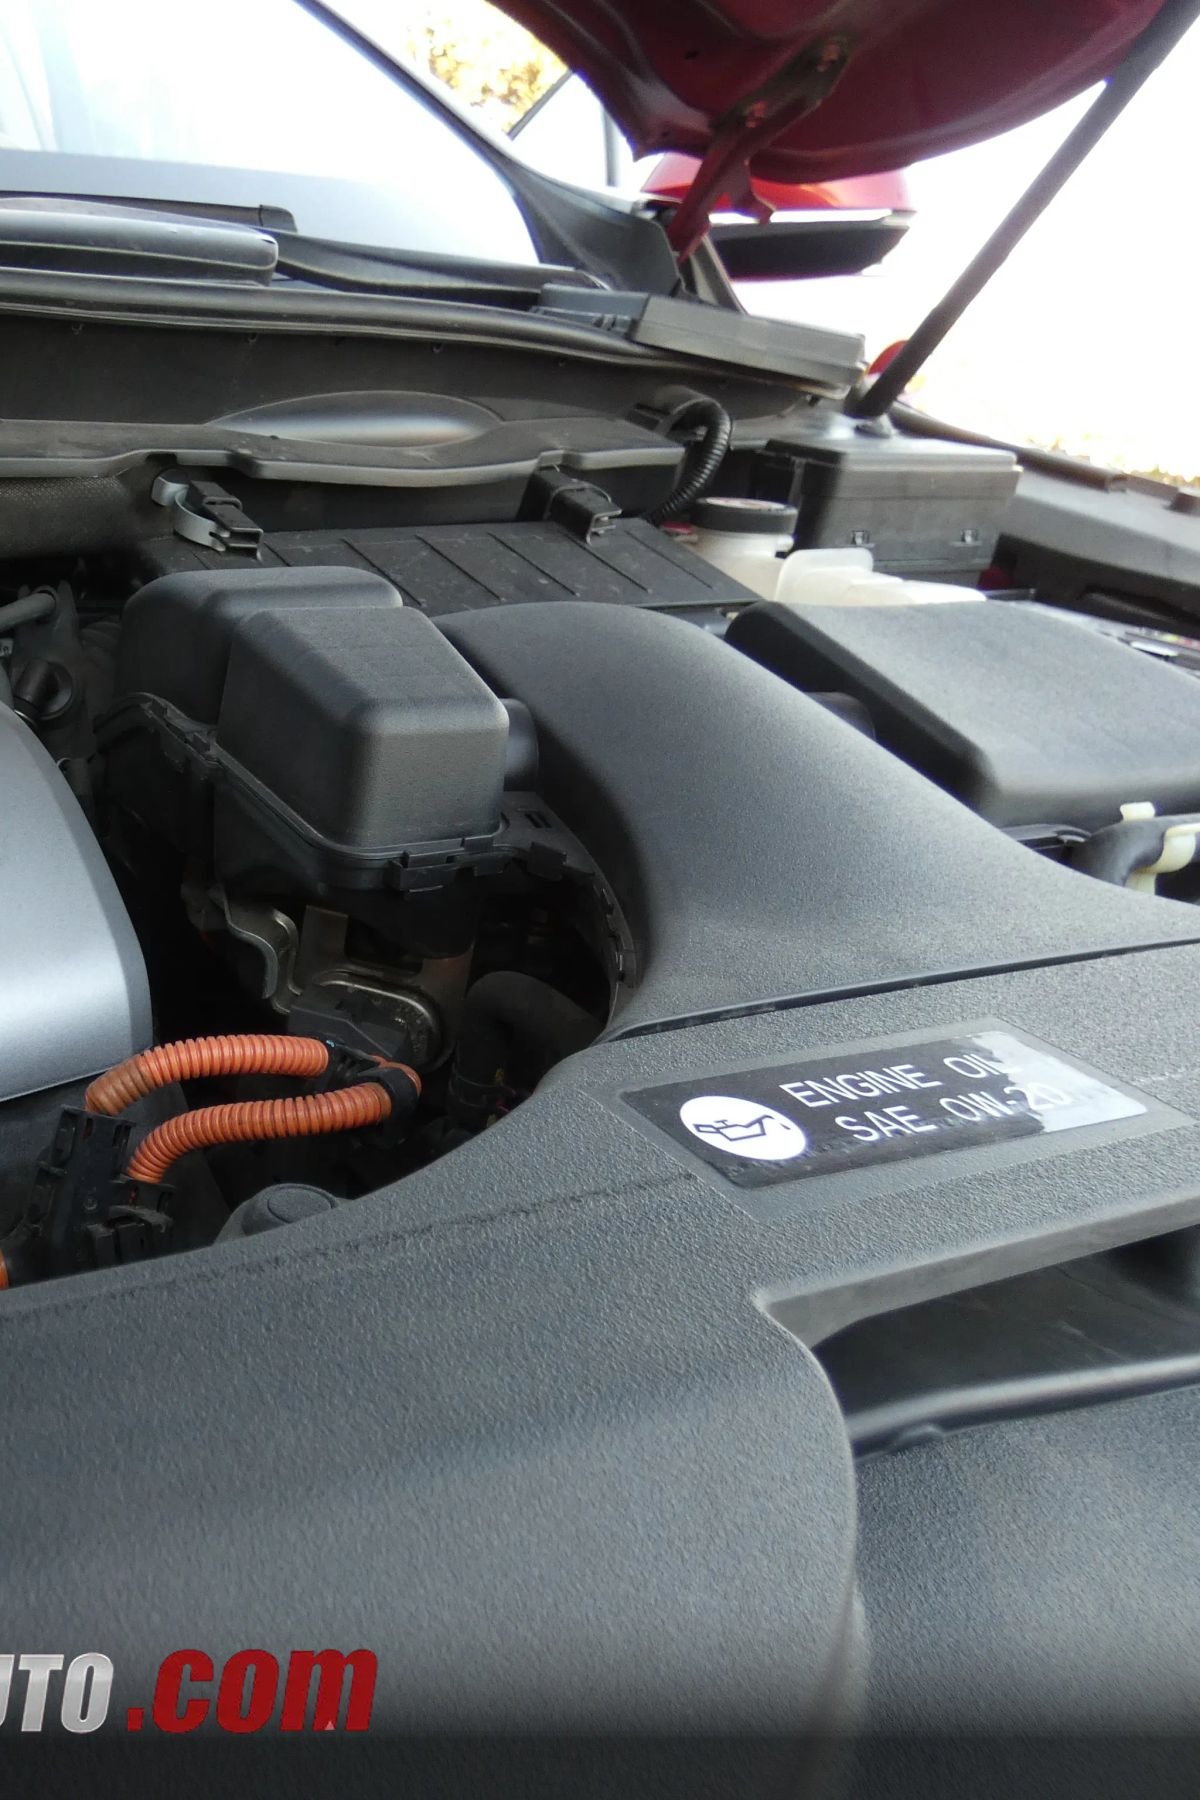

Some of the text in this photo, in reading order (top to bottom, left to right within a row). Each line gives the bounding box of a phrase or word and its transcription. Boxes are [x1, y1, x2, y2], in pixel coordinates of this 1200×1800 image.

[778, 1053, 1022, 1108] ENGINE OIL
[835, 1105, 937, 1142] SAE
